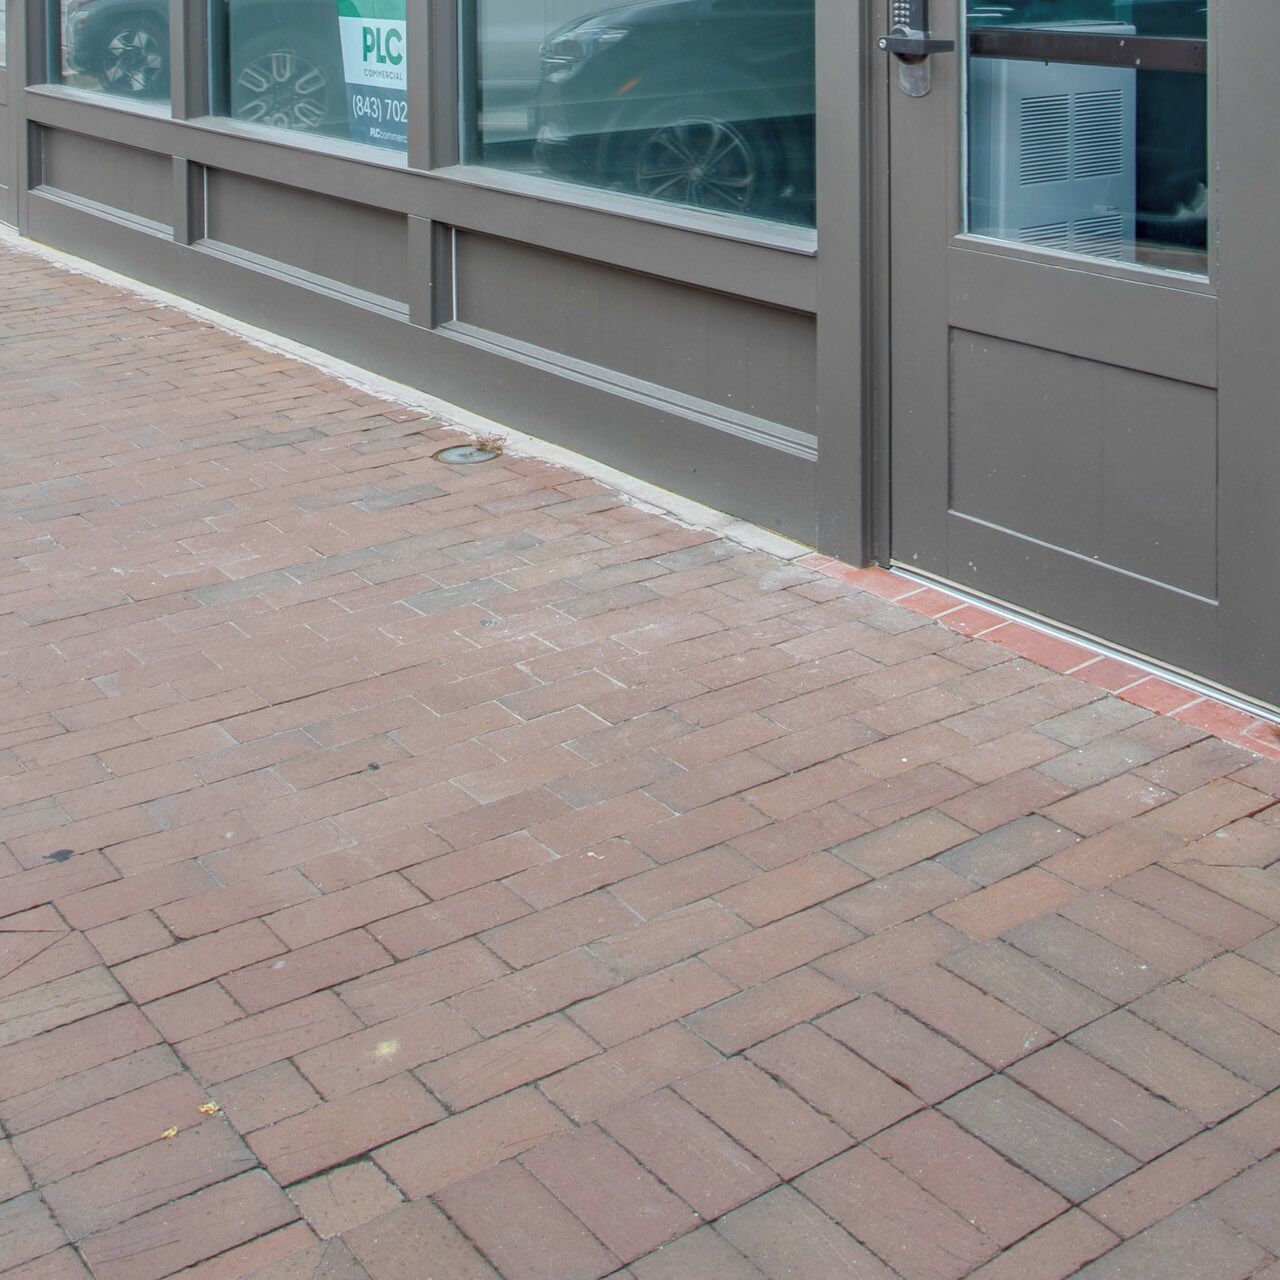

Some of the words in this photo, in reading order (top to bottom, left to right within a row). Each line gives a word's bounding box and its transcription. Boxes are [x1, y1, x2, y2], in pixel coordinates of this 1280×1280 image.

[362, 26, 403, 65] PLC
[363, 68, 403, 81] COMMERCIAL
[352, 94, 382, 122] (843)
